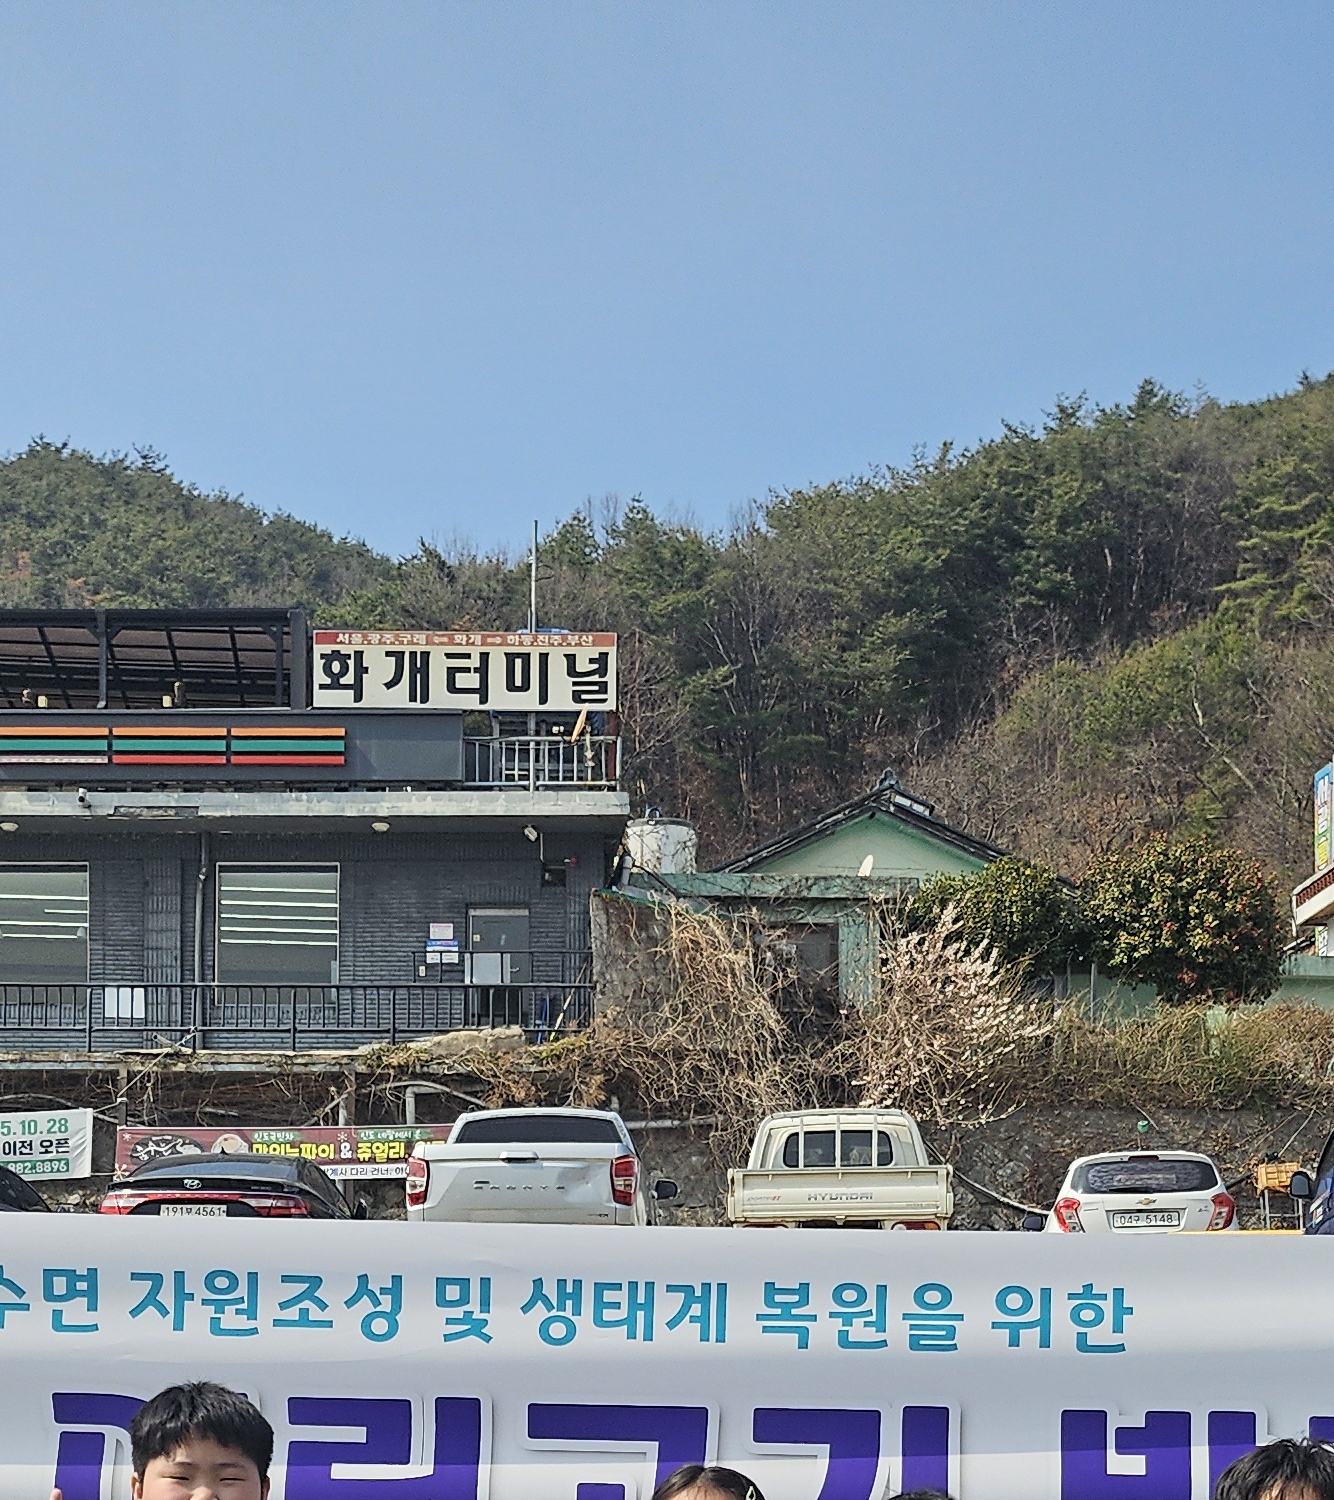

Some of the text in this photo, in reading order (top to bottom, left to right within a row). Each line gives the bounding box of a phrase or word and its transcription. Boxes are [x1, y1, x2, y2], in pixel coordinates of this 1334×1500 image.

[318, 650, 610, 706] 화개터미널
[2, 1139, 34, 1156] 이전
[38, 1137, 71, 1155] 오픈
[339, 1142, 353, 1159] &
[807, 1192, 874, 1202] HYUNDAI
[1145, 1213, 1174, 1224] 5148
[129, 1268, 403, 1343] 자원조성
[435, 1276, 493, 1343] 및
[520, 1277, 728, 1346] 생태계
[755, 1281, 964, 1352] 복원을
[991, 1283, 1134, 1354] 위한
